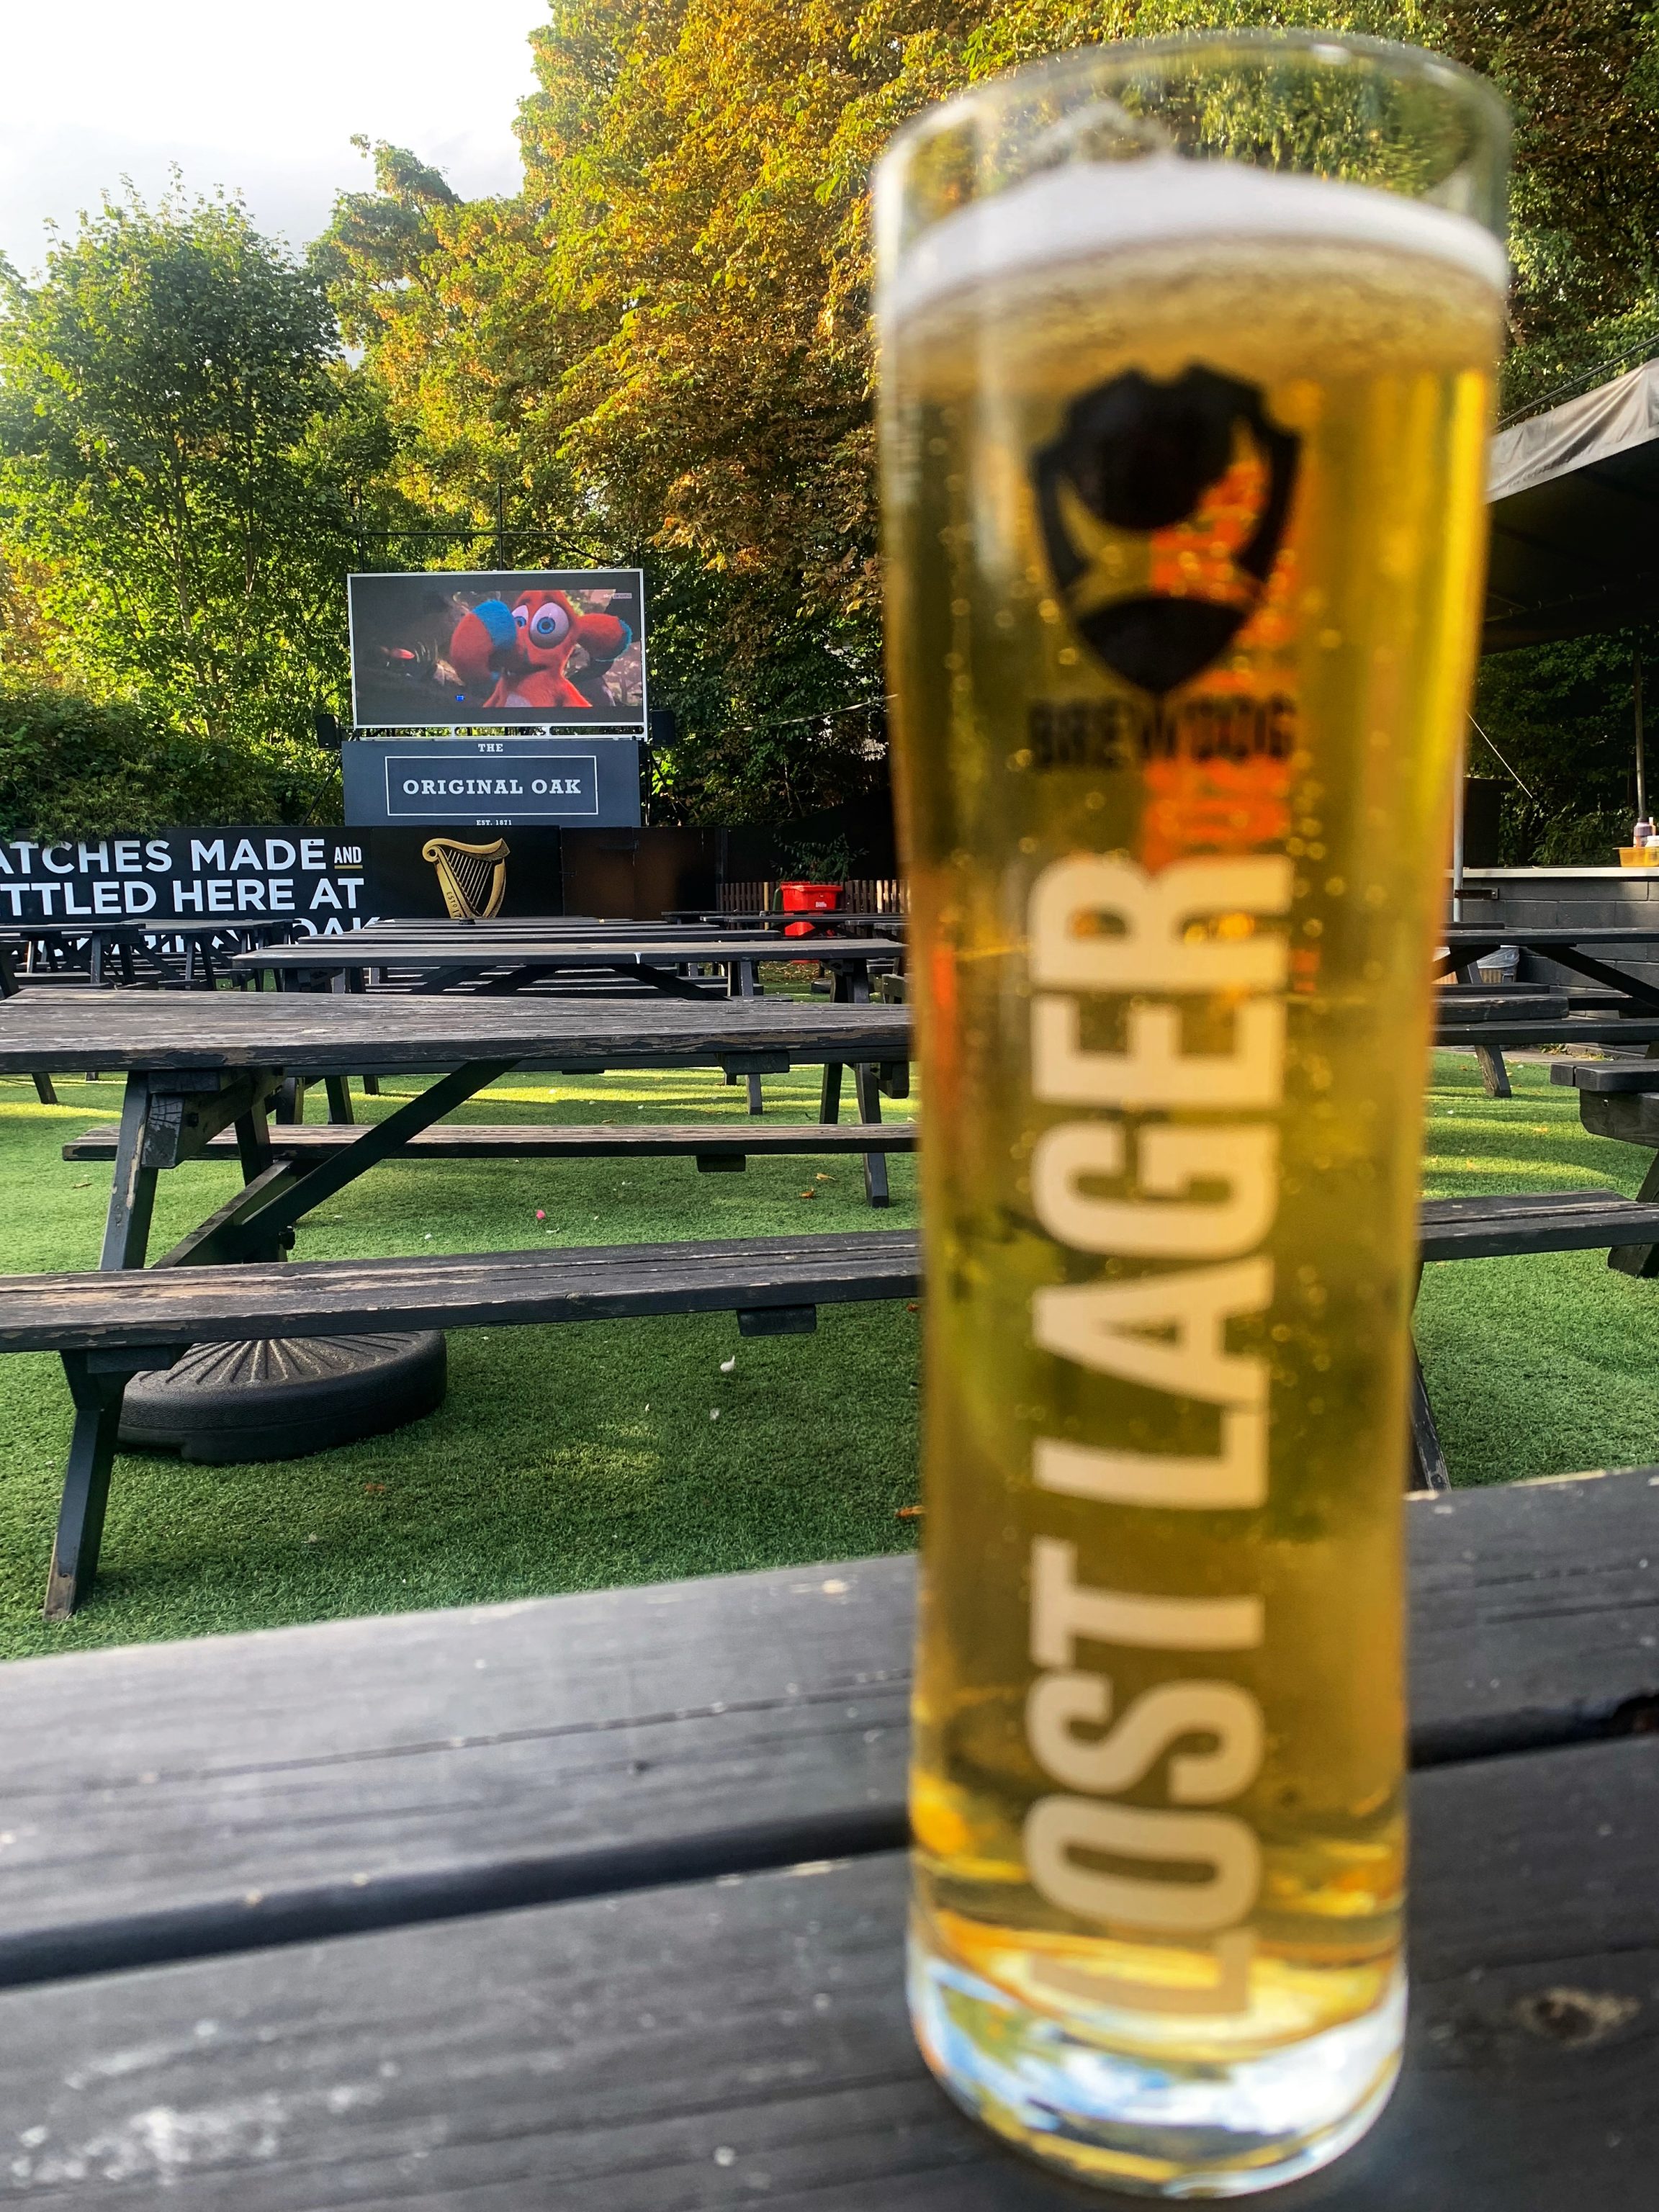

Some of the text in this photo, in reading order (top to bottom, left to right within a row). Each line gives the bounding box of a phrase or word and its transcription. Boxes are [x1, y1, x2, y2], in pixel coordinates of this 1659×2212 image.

[477, 743, 503, 752] THE
[403, 779, 581, 795] ORIGINAL OAK
[190, 839, 327, 871] MADE
[333, 846, 362, 864] AND
[0, 878, 364, 917] TTLED HERE AT
[1023, 855, 1293, 2015] LOST LAGER
